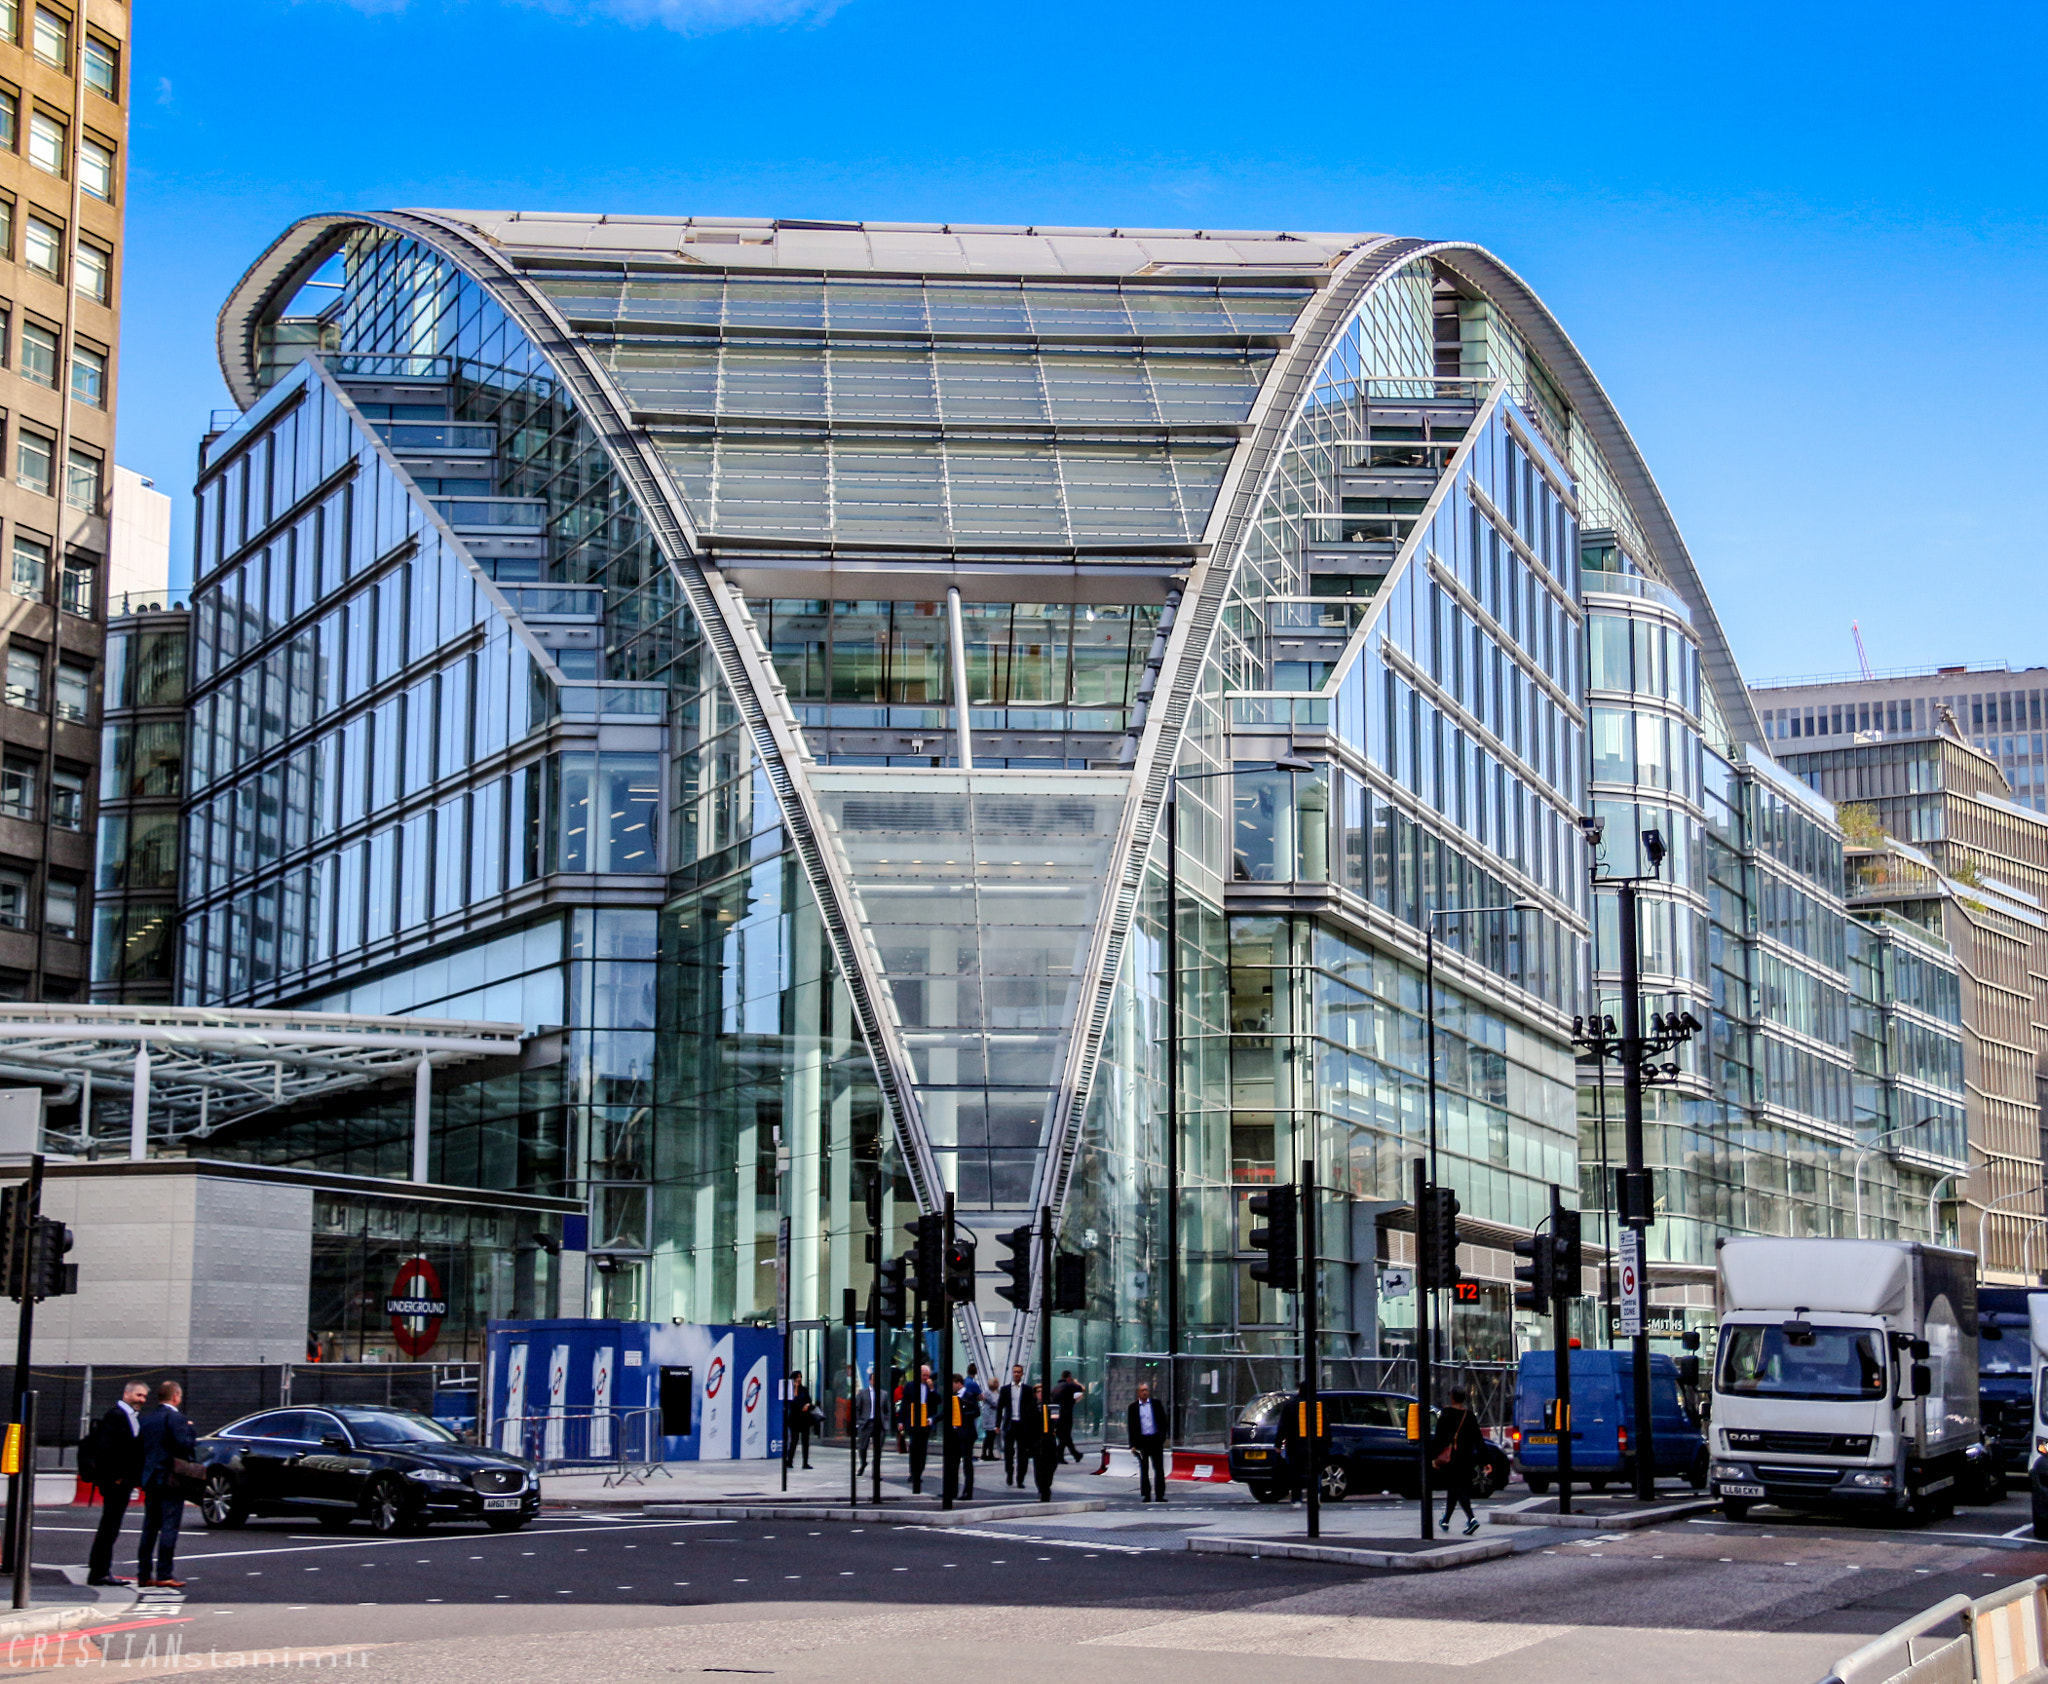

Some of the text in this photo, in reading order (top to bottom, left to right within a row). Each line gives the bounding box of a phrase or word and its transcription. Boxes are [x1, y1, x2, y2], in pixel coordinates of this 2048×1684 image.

[1455, 1283, 1477, 1299] T2
[387, 1300, 446, 1313] UNDERGROUND
[1612, 1319, 1683, 1330] GSMITHS
[1729, 1433, 1761, 1441] DAF
